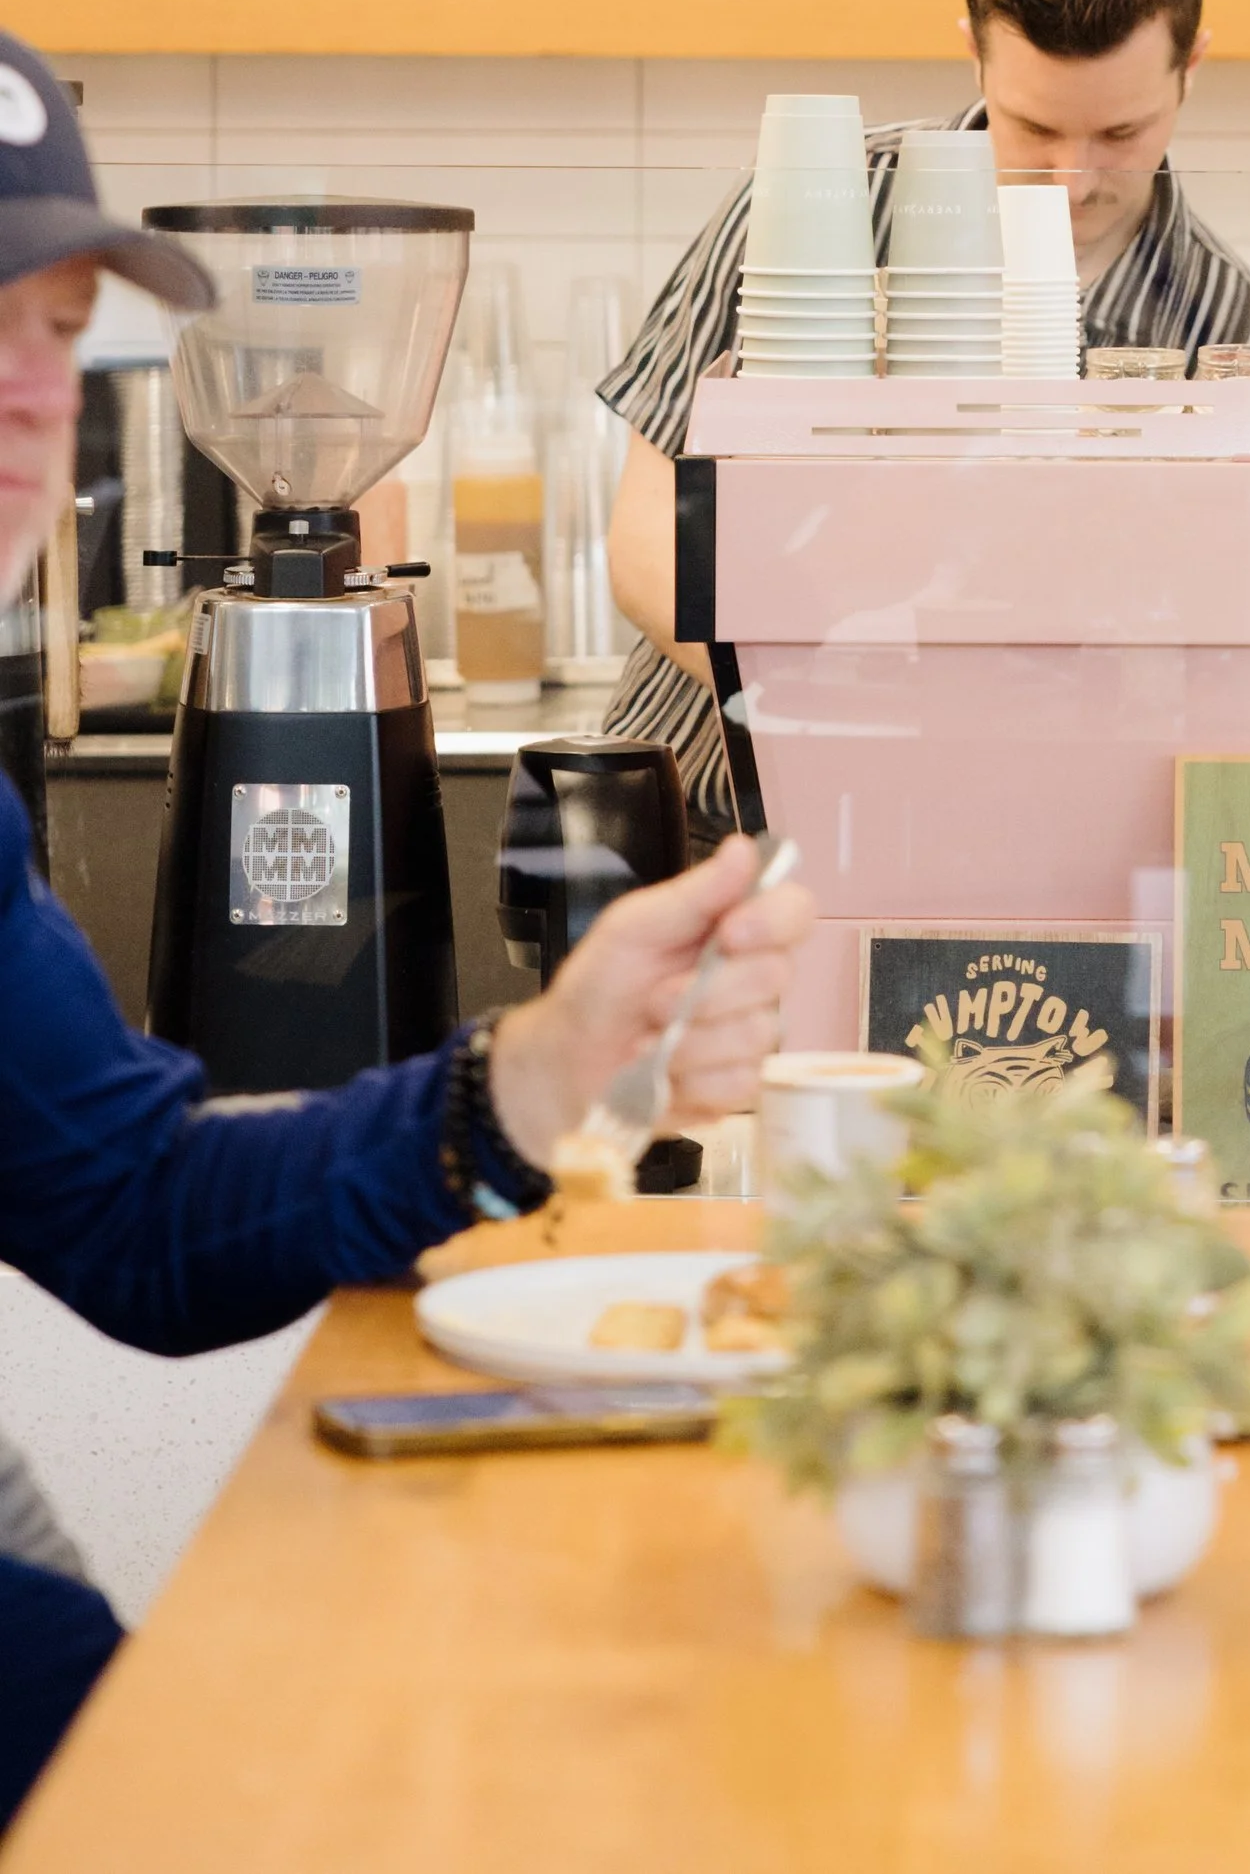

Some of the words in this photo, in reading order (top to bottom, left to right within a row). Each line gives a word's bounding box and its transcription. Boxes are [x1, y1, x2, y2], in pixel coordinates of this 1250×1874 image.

[274, 271, 303, 280] DANGER
[309, 271, 339, 280] PELIGRO
[966, 954, 1047, 982] SERVING
[905, 981, 1114, 1090] TUMPTOW
